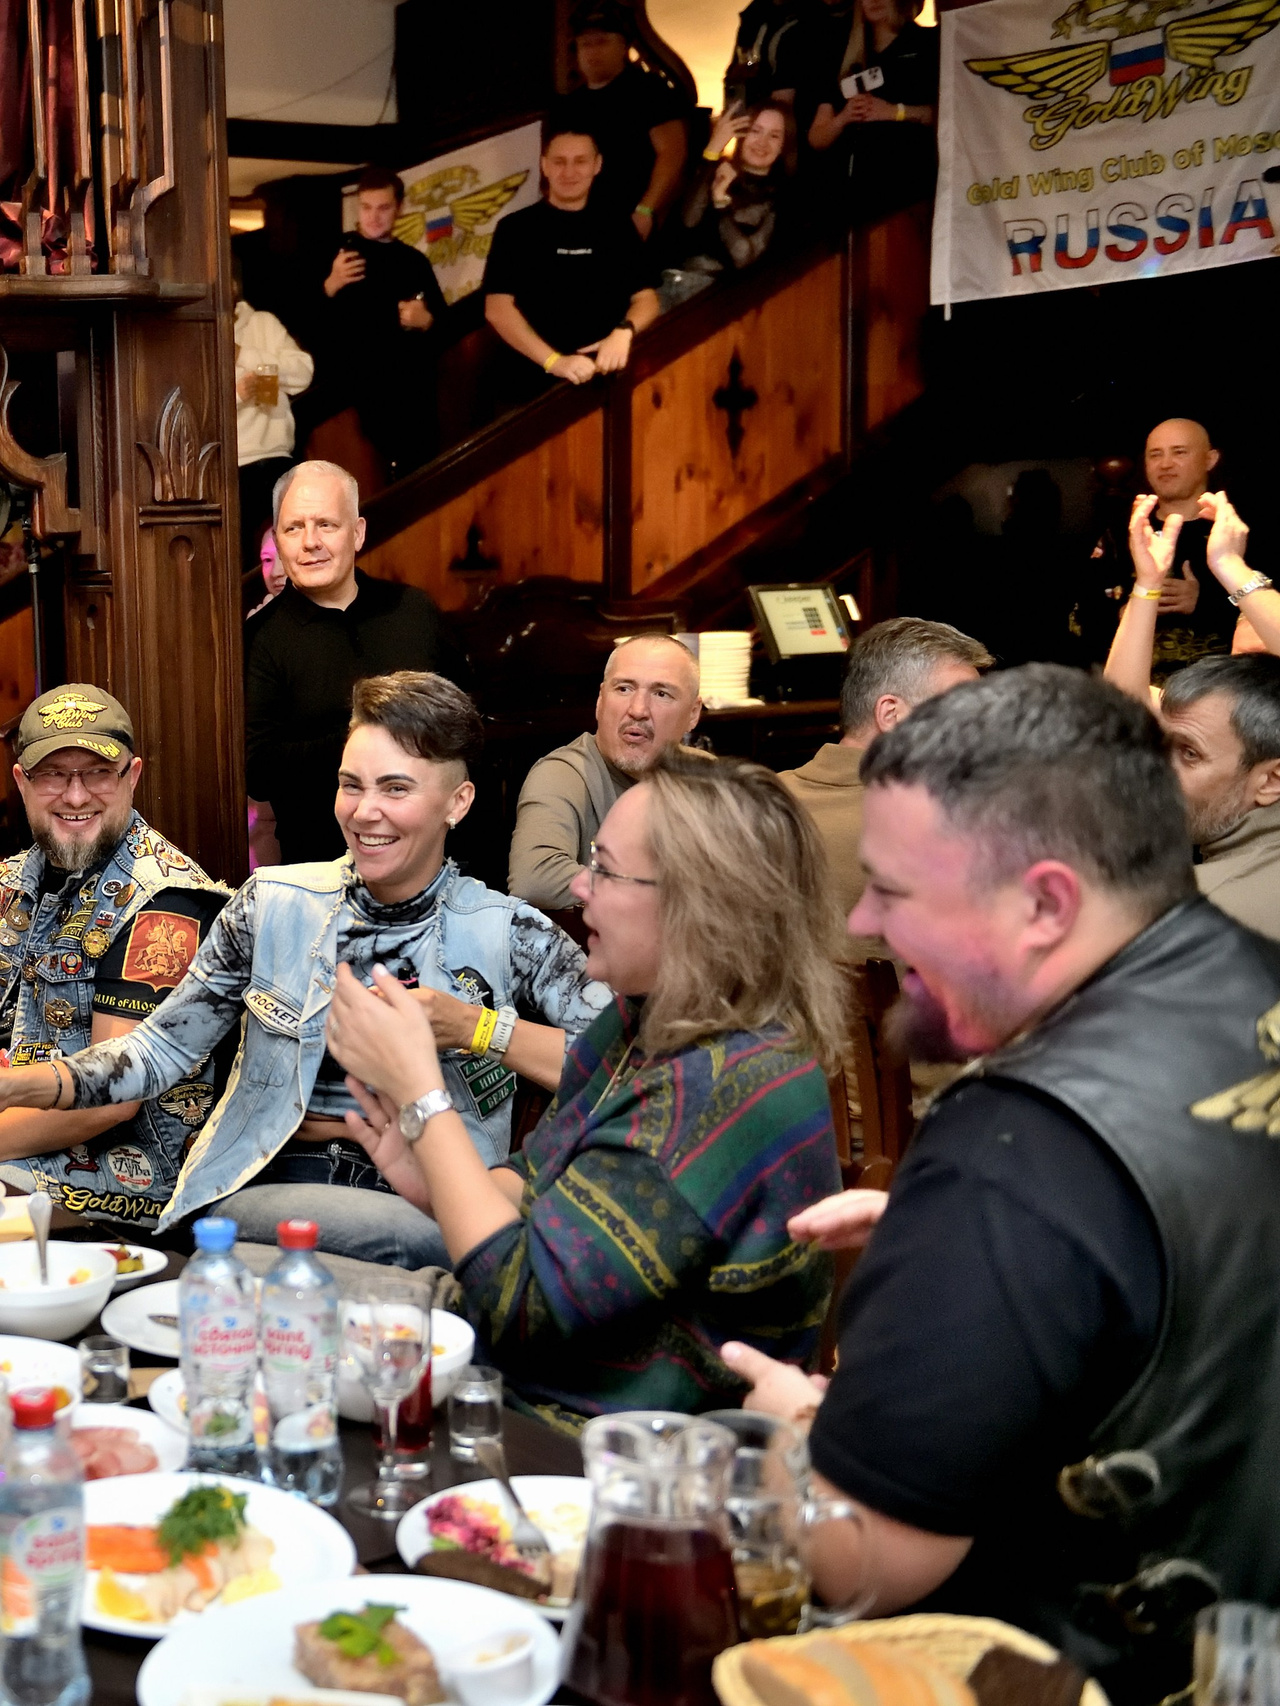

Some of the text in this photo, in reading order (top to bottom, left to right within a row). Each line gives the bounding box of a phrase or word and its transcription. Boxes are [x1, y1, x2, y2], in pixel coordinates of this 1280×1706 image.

[1026, 166, 1095, 197] Wing
[1100, 149, 1166, 183] Club
[1173, 139, 1205, 170] of
[1004, 177, 1275, 277] RUSSIA
[250, 993, 300, 1030] ROCKET
[62, 1185, 162, 1218] GoldWin
